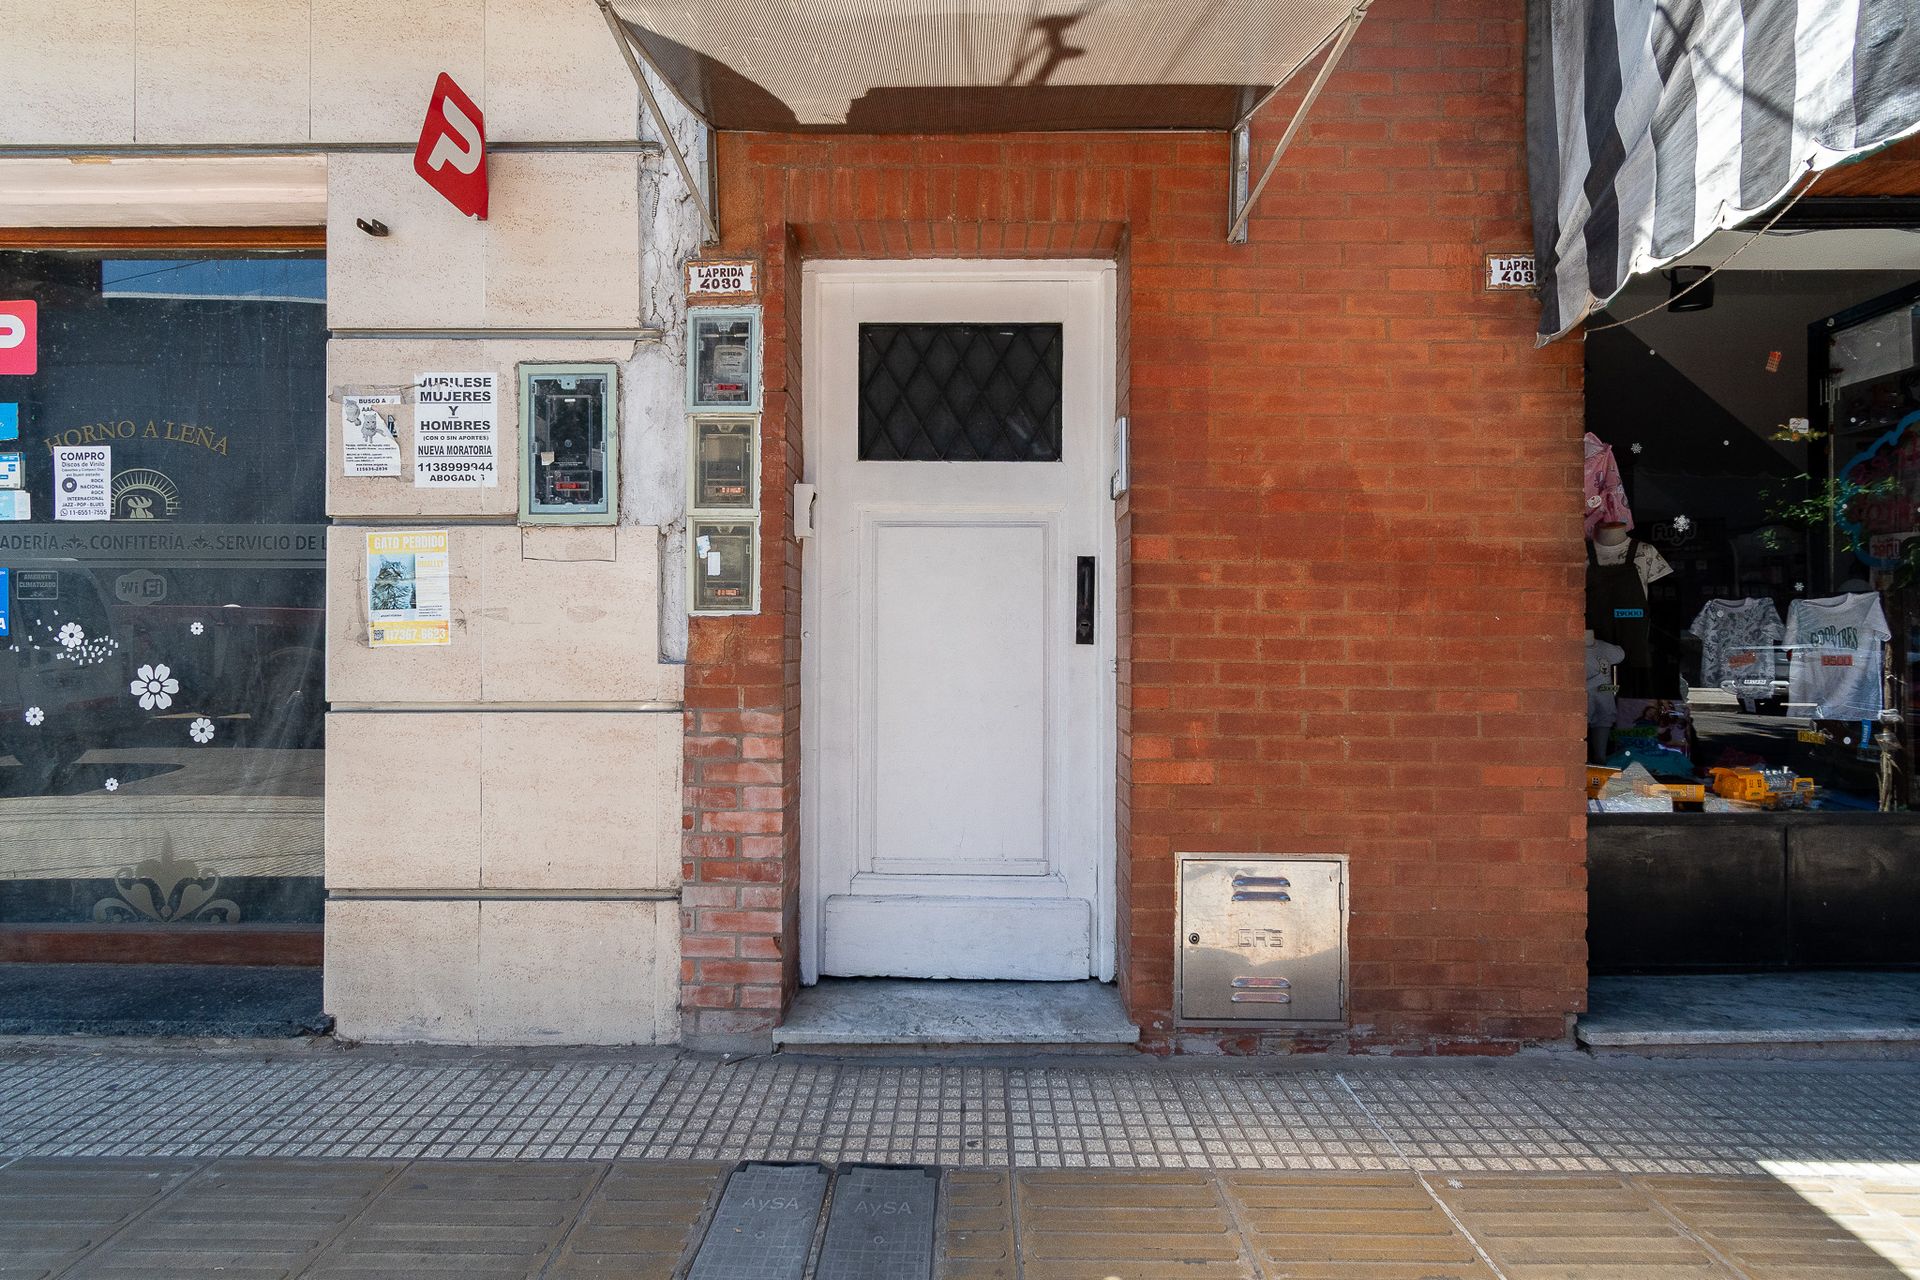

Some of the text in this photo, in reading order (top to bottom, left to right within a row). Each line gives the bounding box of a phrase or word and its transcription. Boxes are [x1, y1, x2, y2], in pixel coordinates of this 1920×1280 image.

[1500, 260, 1536, 270] LAPRI
[698, 267, 744, 278] LAPRIDA
[700, 278, 741, 289] 4030
[420, 391, 491, 402] MUJERES
[448, 405, 459, 416] Y
[420, 420, 491, 431] HOMBRES
[43, 420, 229, 456] HORNO A LEÑA
[418, 445, 492, 455] NUEVA MORATORIA
[60, 452, 105, 461] COMPRO
[418, 462, 493, 472] 1138999944
[90, 533, 184, 550] CONFITERÍA
[216, 535, 291, 550] SERVICIO
[295, 535, 316, 550] DE
[374, 534, 445, 550] GATO PERDIDO
[1238, 928, 1283, 948] GAS
[743, 1197, 799, 1212] AySA
[854, 1200, 912, 1217] AySA
